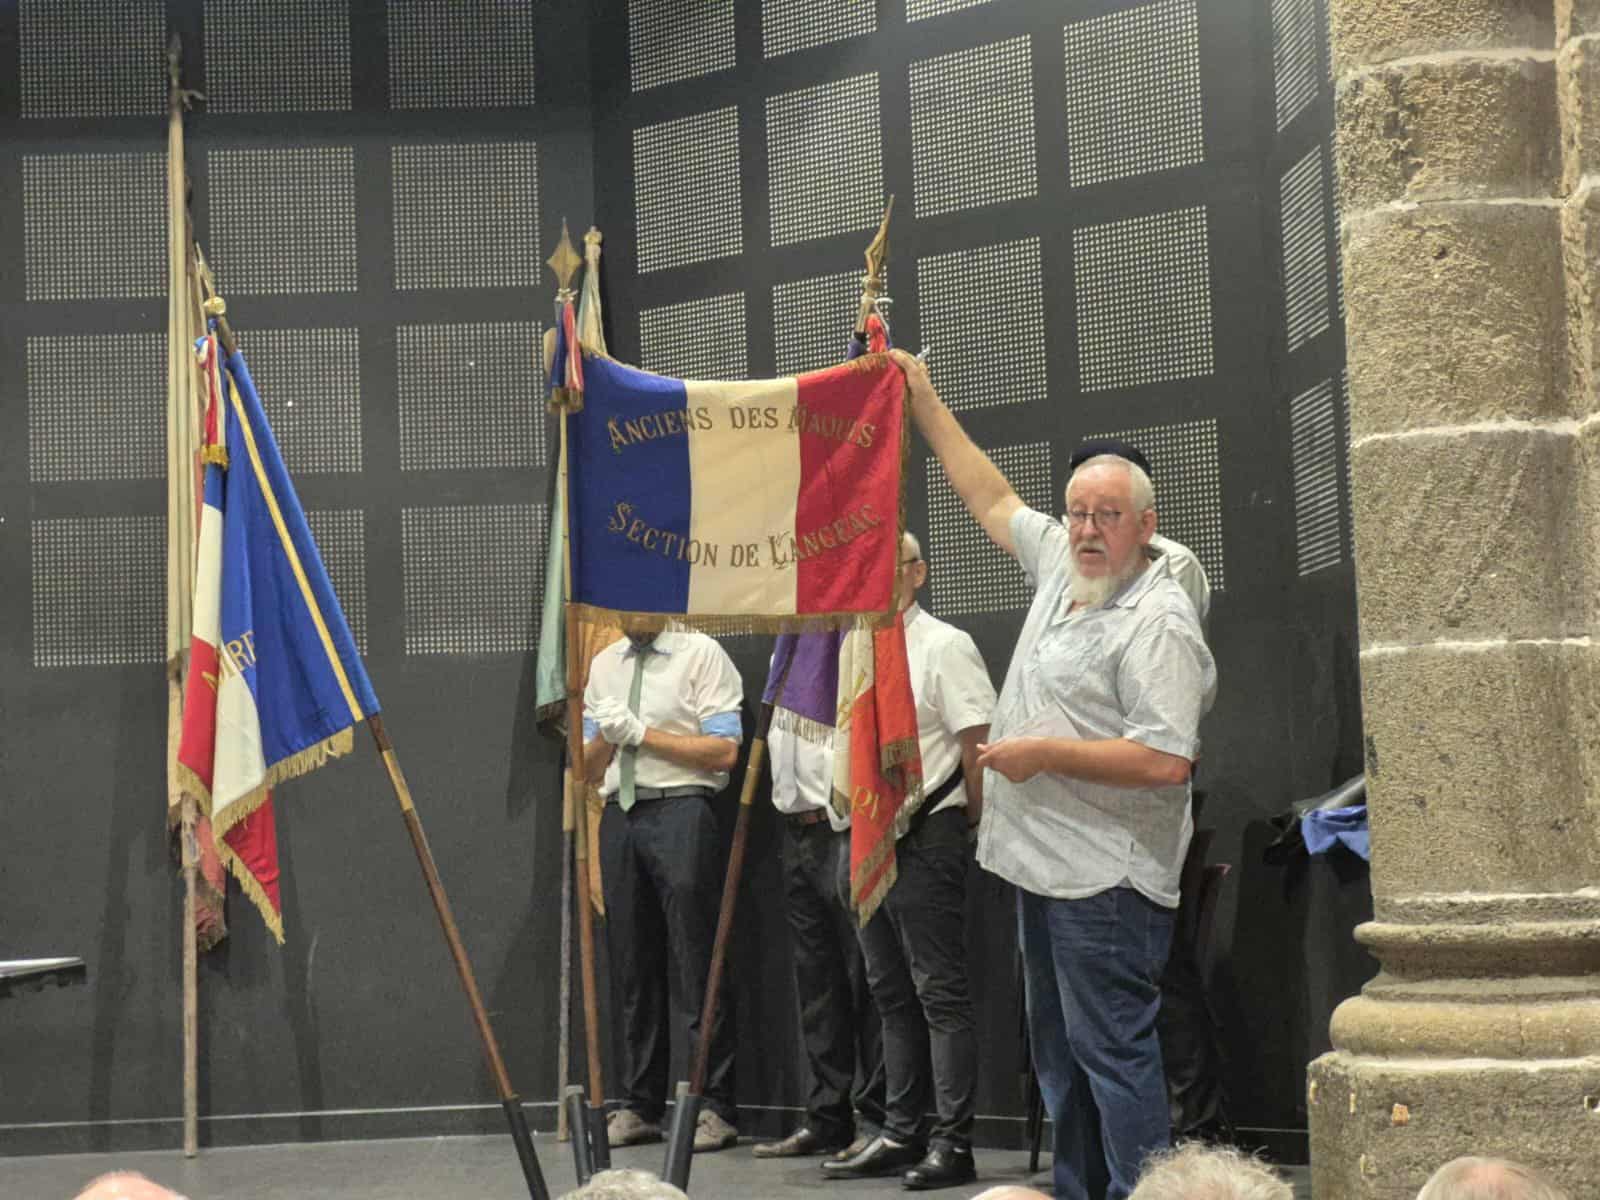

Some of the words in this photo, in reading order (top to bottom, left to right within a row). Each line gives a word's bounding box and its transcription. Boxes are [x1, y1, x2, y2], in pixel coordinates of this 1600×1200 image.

[606, 406, 713, 450] ANCIENS
[729, 405, 779, 430] DES
[786, 402, 876, 449] MAQUIS
[607, 500, 719, 568] SECTION
[730, 543, 759, 568] DE
